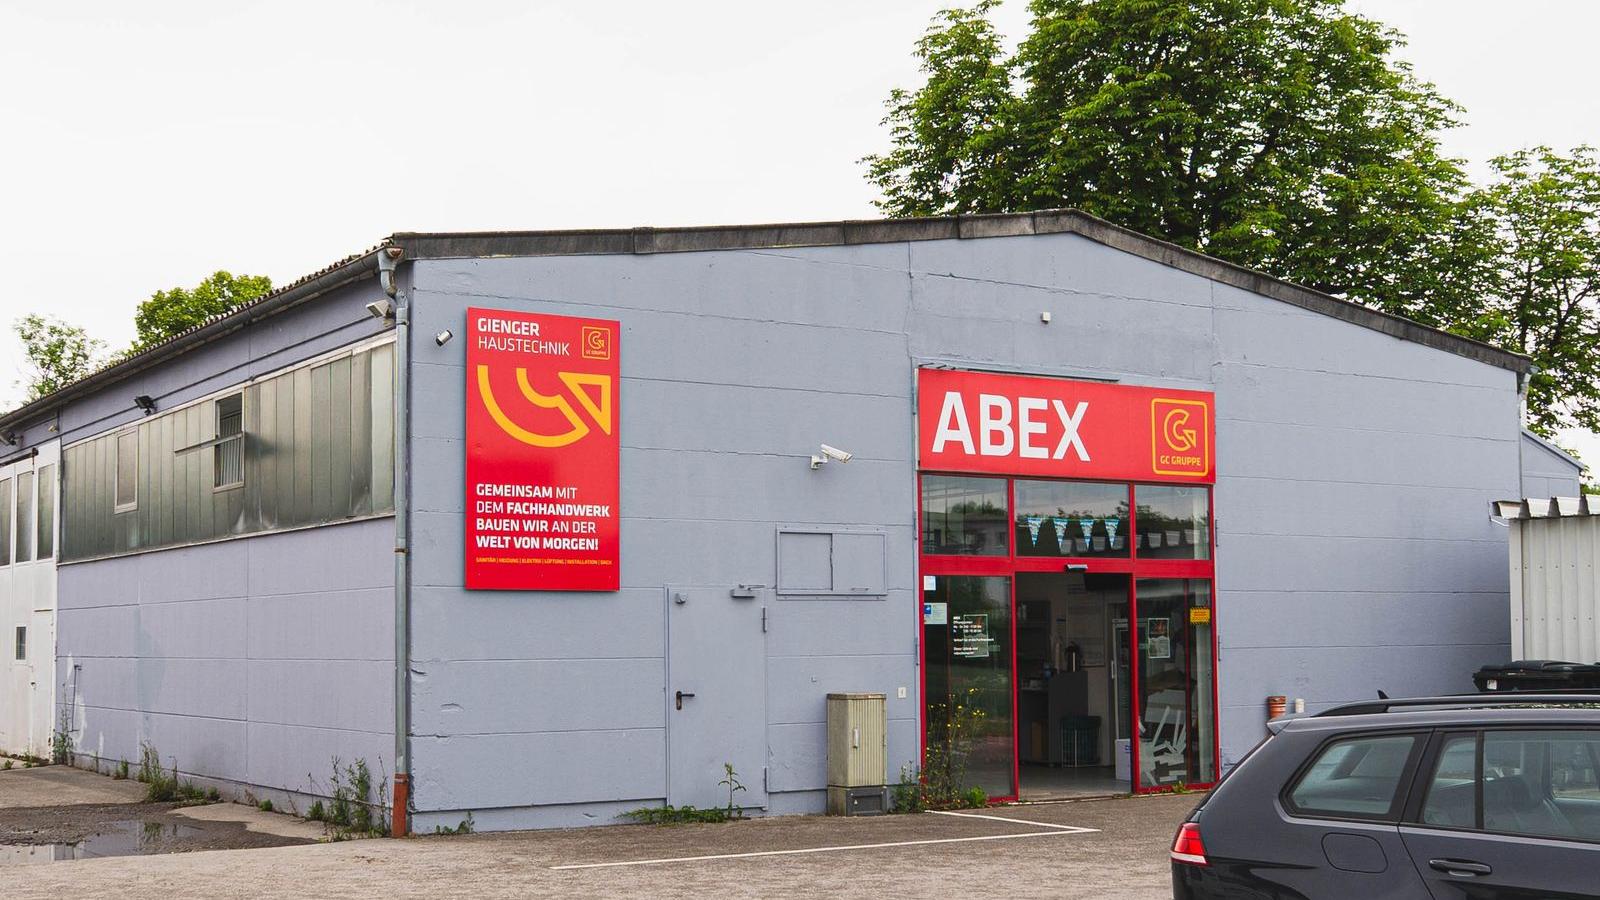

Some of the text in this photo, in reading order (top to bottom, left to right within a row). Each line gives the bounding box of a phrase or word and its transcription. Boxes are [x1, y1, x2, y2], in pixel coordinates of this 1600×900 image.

[478, 318, 539, 336] GIENGER
[478, 336, 570, 356] HAUSTECHNIK
[932, 391, 1091, 462] ABEX
[1160, 455, 1201, 466] GC GRUPPE
[476, 483, 578, 499] GEMEINSAM MIT
[476, 501, 610, 518] DEM FACHHANDWERK
[476, 518, 596, 534] BAUEN WIR AN DER
[476, 535, 599, 551] WELT VON MORGEN!
